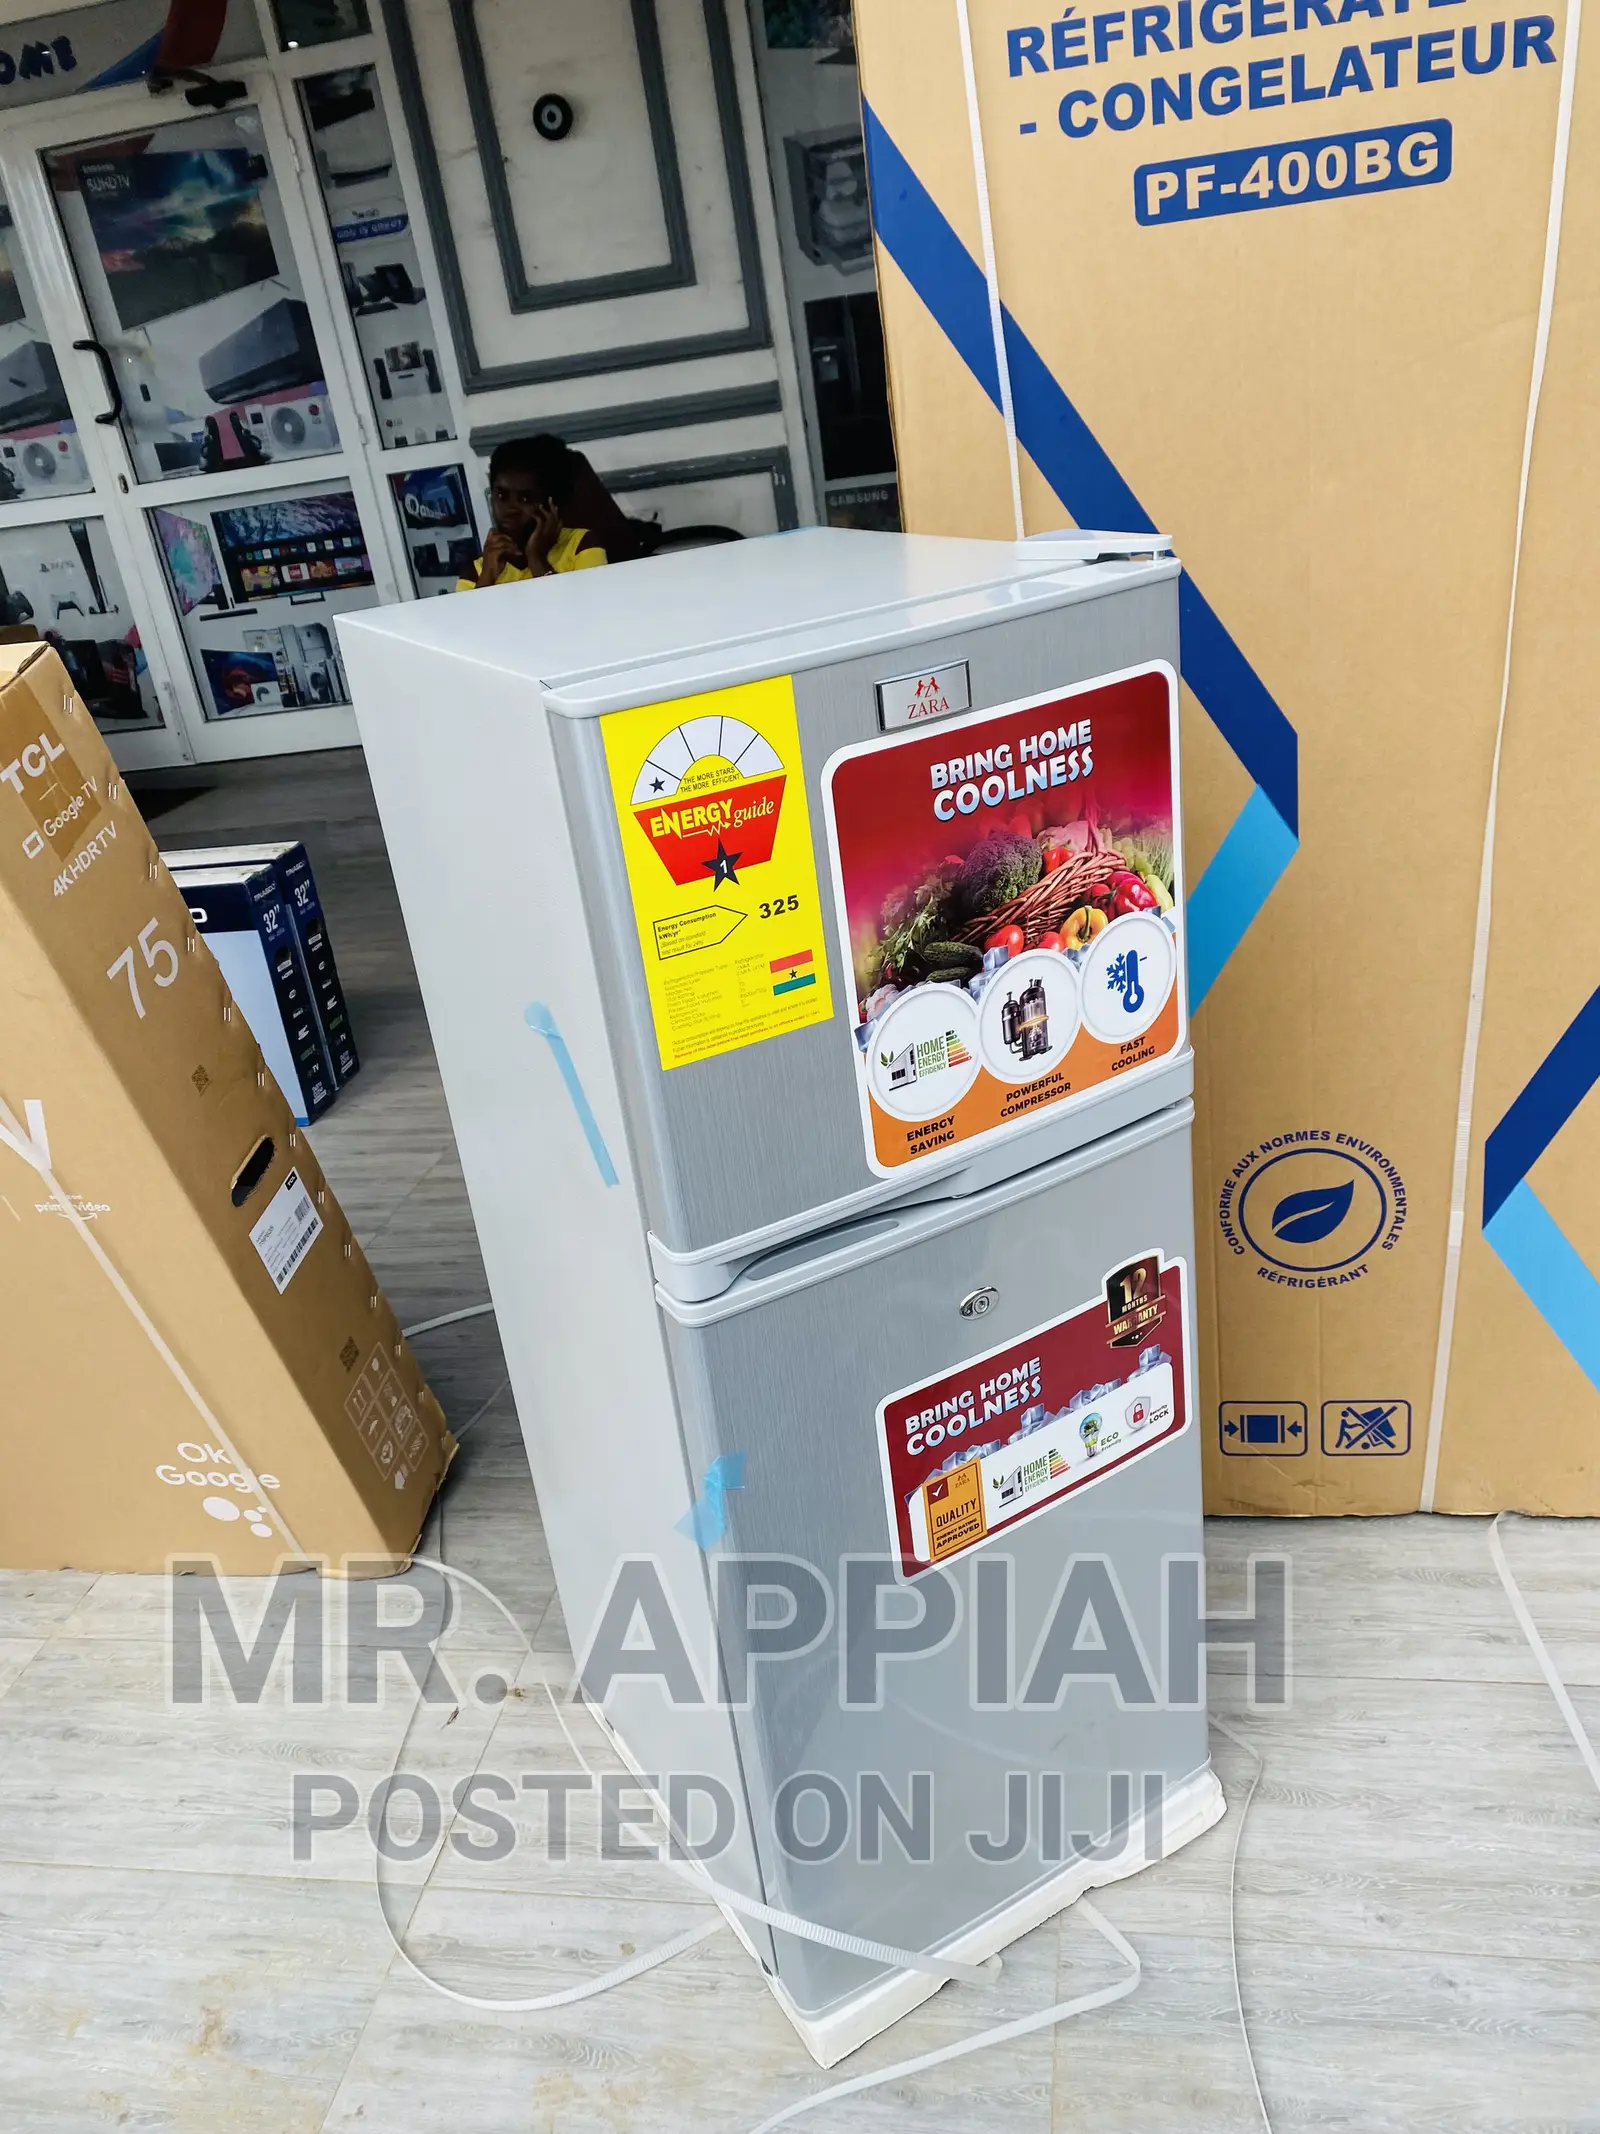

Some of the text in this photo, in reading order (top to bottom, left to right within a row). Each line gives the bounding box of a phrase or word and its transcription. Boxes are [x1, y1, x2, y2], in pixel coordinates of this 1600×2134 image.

[1058, 15, 1558, 138] CONGELATEUR
[1145, 131, 1440, 216] PF-400BG
[907, 696, 949, 719] ZARA
[0, 733, 65, 794] TCL
[930, 719, 1092, 789] BRING HOME
[680, 773, 740, 793] THE MORE EFFICIENT
[683, 767, 735, 784] THE MORE STARS
[933, 746, 1094, 821] COOLNESS
[43, 776, 98, 837] Google TV
[650, 796, 775, 839] ENERGY guide
[53, 820, 119, 896] 4K HDR TV
[720, 859, 728, 874] 1
[758, 894, 800, 919] 325
[657, 912, 717, 934] Energy Consumption
[107, 917, 179, 1020] 75
[916, 1036, 945, 1058] HOME
[1111, 1045, 1155, 1072] COOLING
[1120, 1036, 1146, 1055] FAST
[918, 1050, 945, 1069] ENERGY
[1000, 1082, 1071, 1118] COMPRESSOR
[1005, 1072, 1064, 1103] POWERFUL
[906, 1115, 955, 1142] ENERGY
[910, 1130, 955, 1155] SAVING
[1219, 1130, 1408, 1256] CONFORME AUX NORMES ENVIRONMENTALES
[1120, 1267, 1147, 1304] 12
[1257, 1263, 1369, 1289] RÉFRIGÉRANT
[1121, 1295, 1148, 1313] MONTHS
[905, 1356, 1041, 1437] BRING HOME
[906, 1376, 1043, 1456] COOLNESS
[1149, 1409, 1169, 1424] LOCK
[1100, 1431, 1119, 1447] ECO
[177, 1442, 232, 1464] Ok
[1023, 1455, 1048, 1477] HOME
[155, 1465, 281, 1494] Googe
[1024, 1466, 1048, 1485] ENERGY
[936, 1498, 977, 1528] QUALITY
[936, 1526, 958, 1541] ENERGY
[936, 1523, 980, 1549] APPROVED
